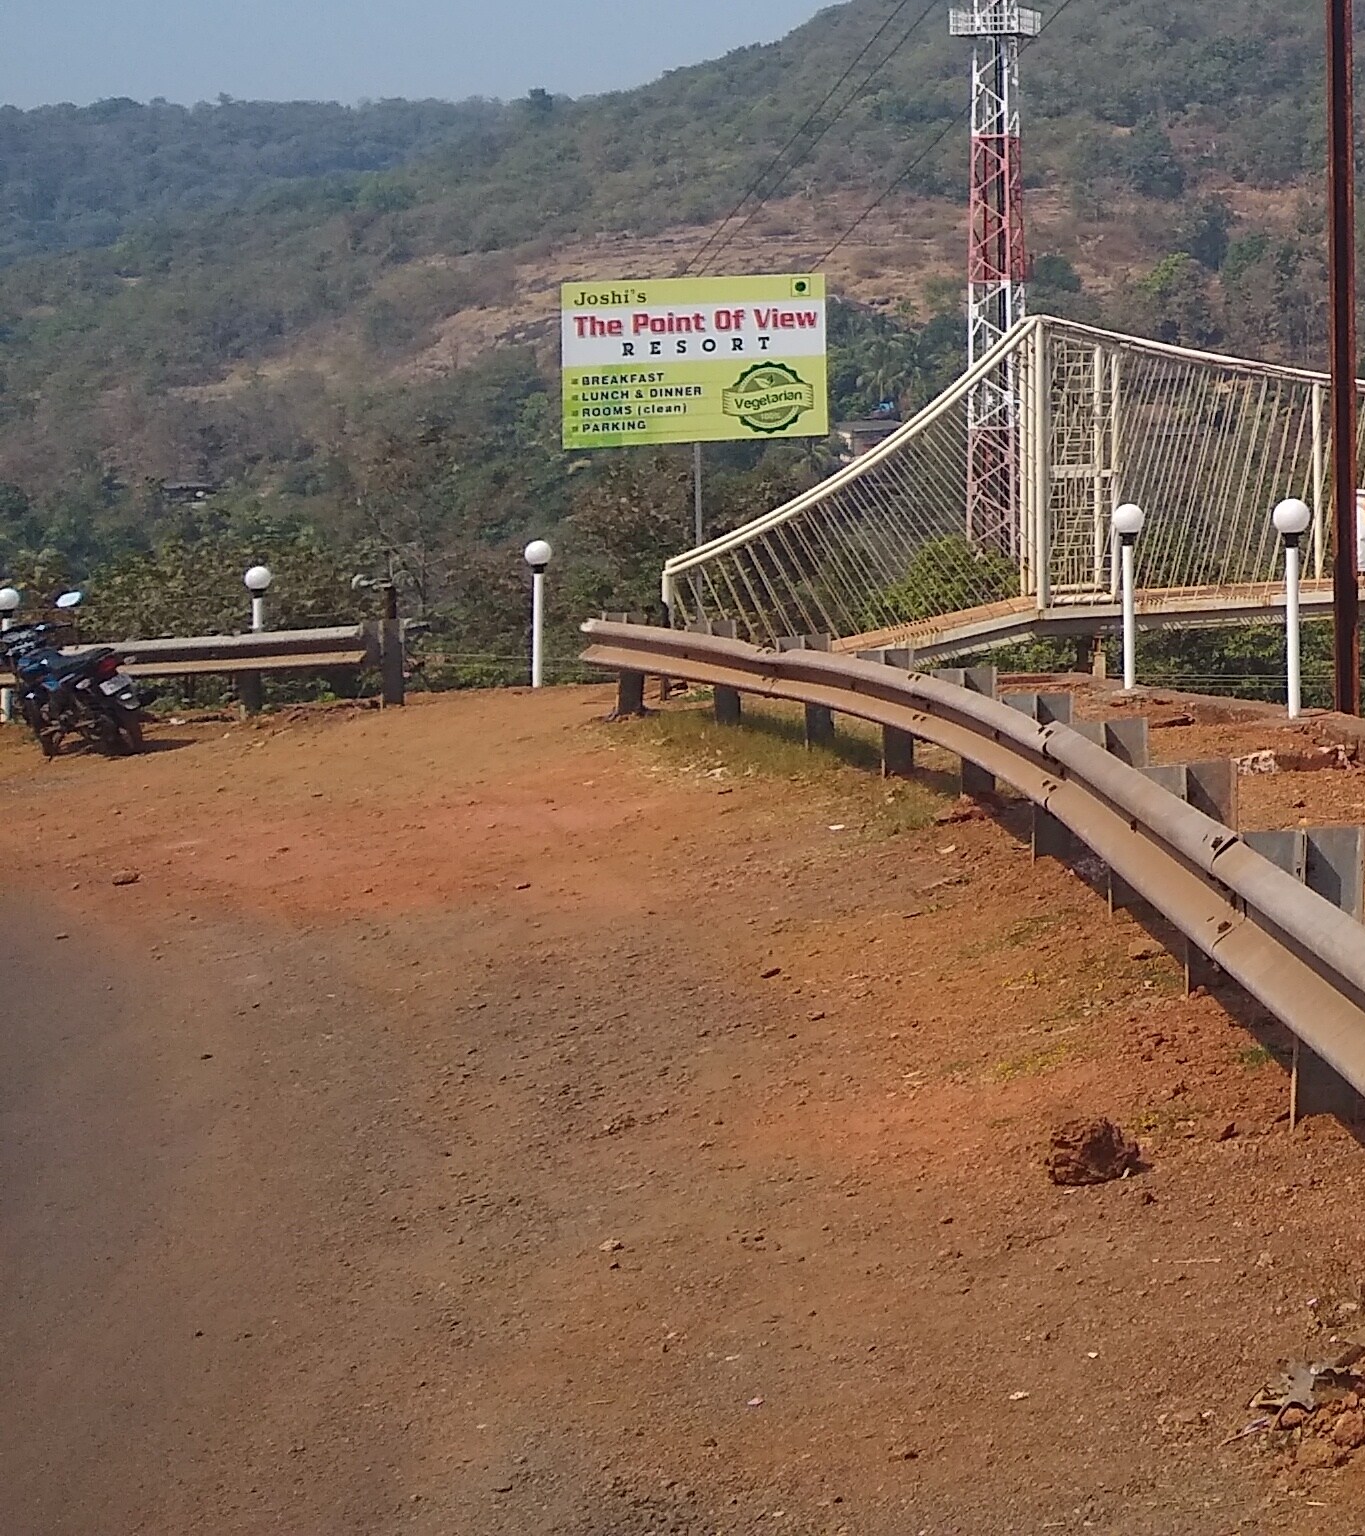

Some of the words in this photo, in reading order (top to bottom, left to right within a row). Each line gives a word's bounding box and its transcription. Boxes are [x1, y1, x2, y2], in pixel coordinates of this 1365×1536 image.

[574, 289, 647, 306] Joshi's
[574, 316, 623, 337] The
[632, 312, 706, 334] Point
[714, 309, 746, 332] Of
[753, 307, 818, 331] View
[622, 337, 770, 356] RESORT
[581, 372, 665, 386] BREAKFAST
[581, 390, 629, 401] LUNCH
[634, 389, 644, 399] &
[650, 386, 702, 398] DINNER
[581, 405, 632, 418] ROOMS
[637, 403, 687, 416] (clean)
[581, 420, 647, 433] PARKING
